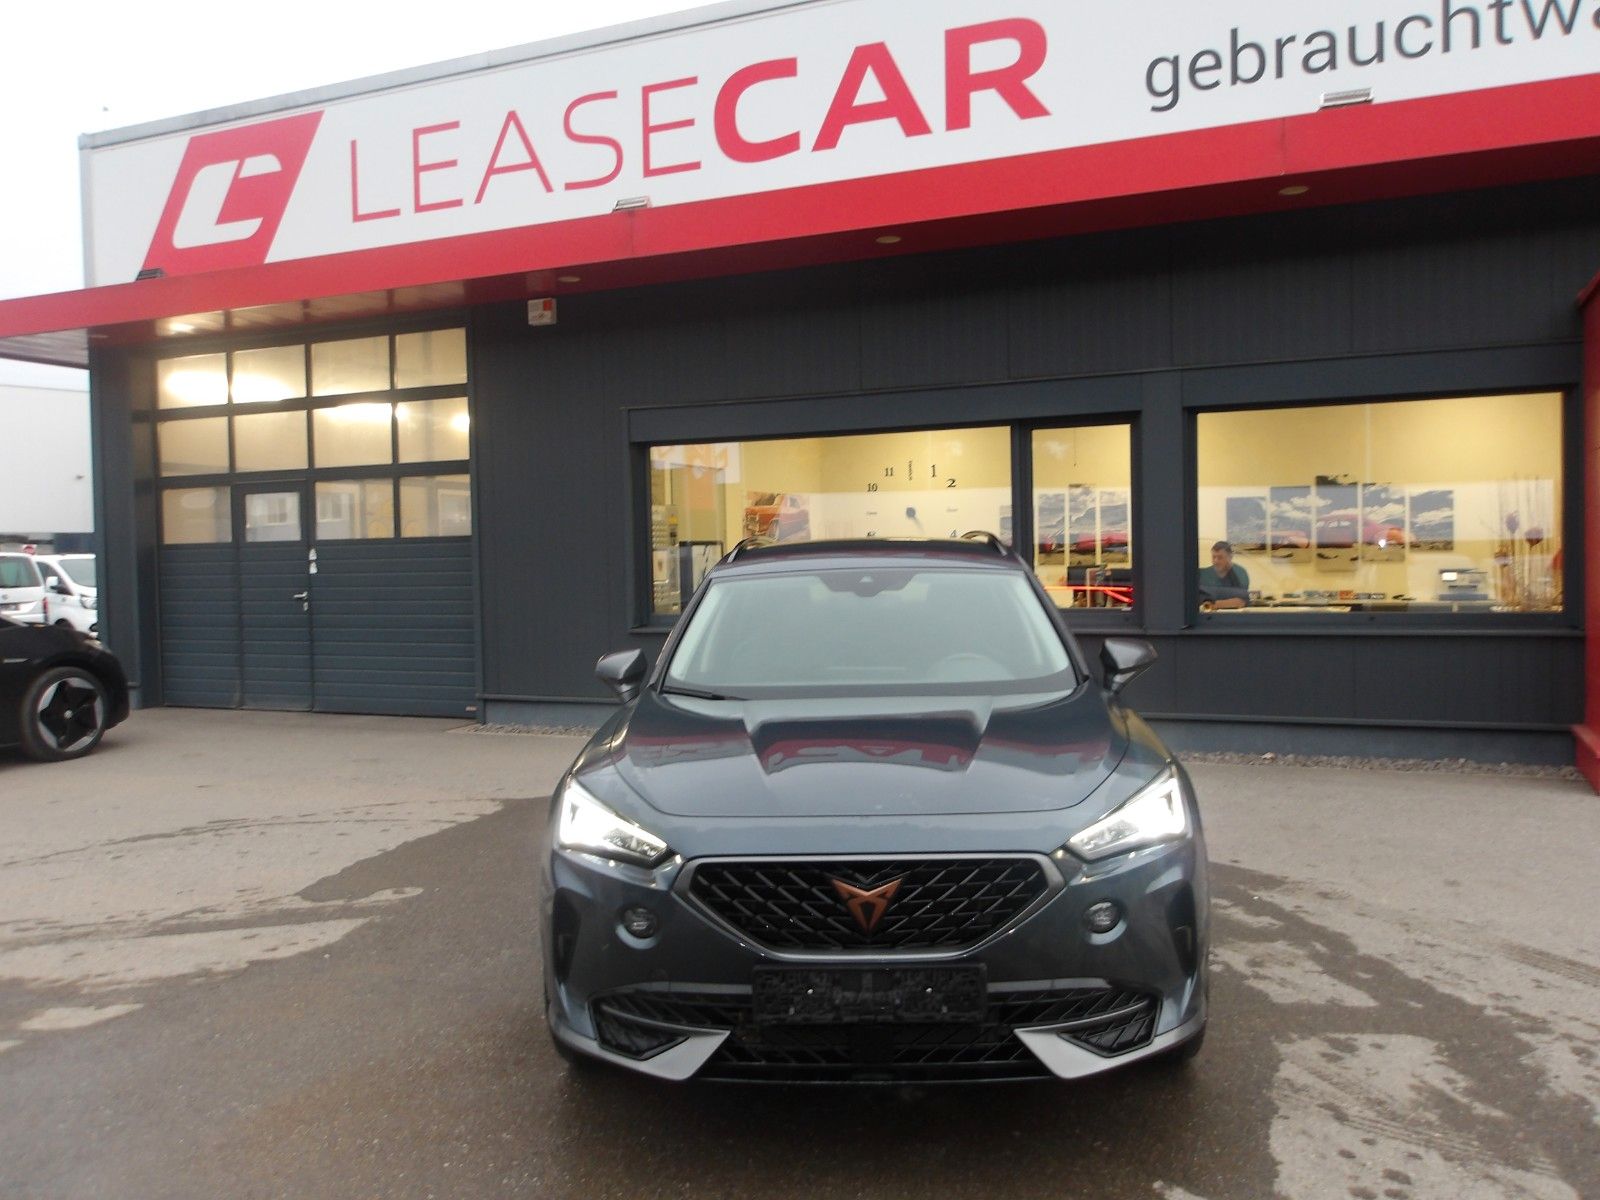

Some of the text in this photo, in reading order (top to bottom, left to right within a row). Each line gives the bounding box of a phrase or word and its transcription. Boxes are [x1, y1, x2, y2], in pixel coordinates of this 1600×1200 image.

[1145, 0, 1600, 112] gebrauchtw
[350, 16, 1050, 224] LEASECAR
[947, 478, 956, 488] 2
